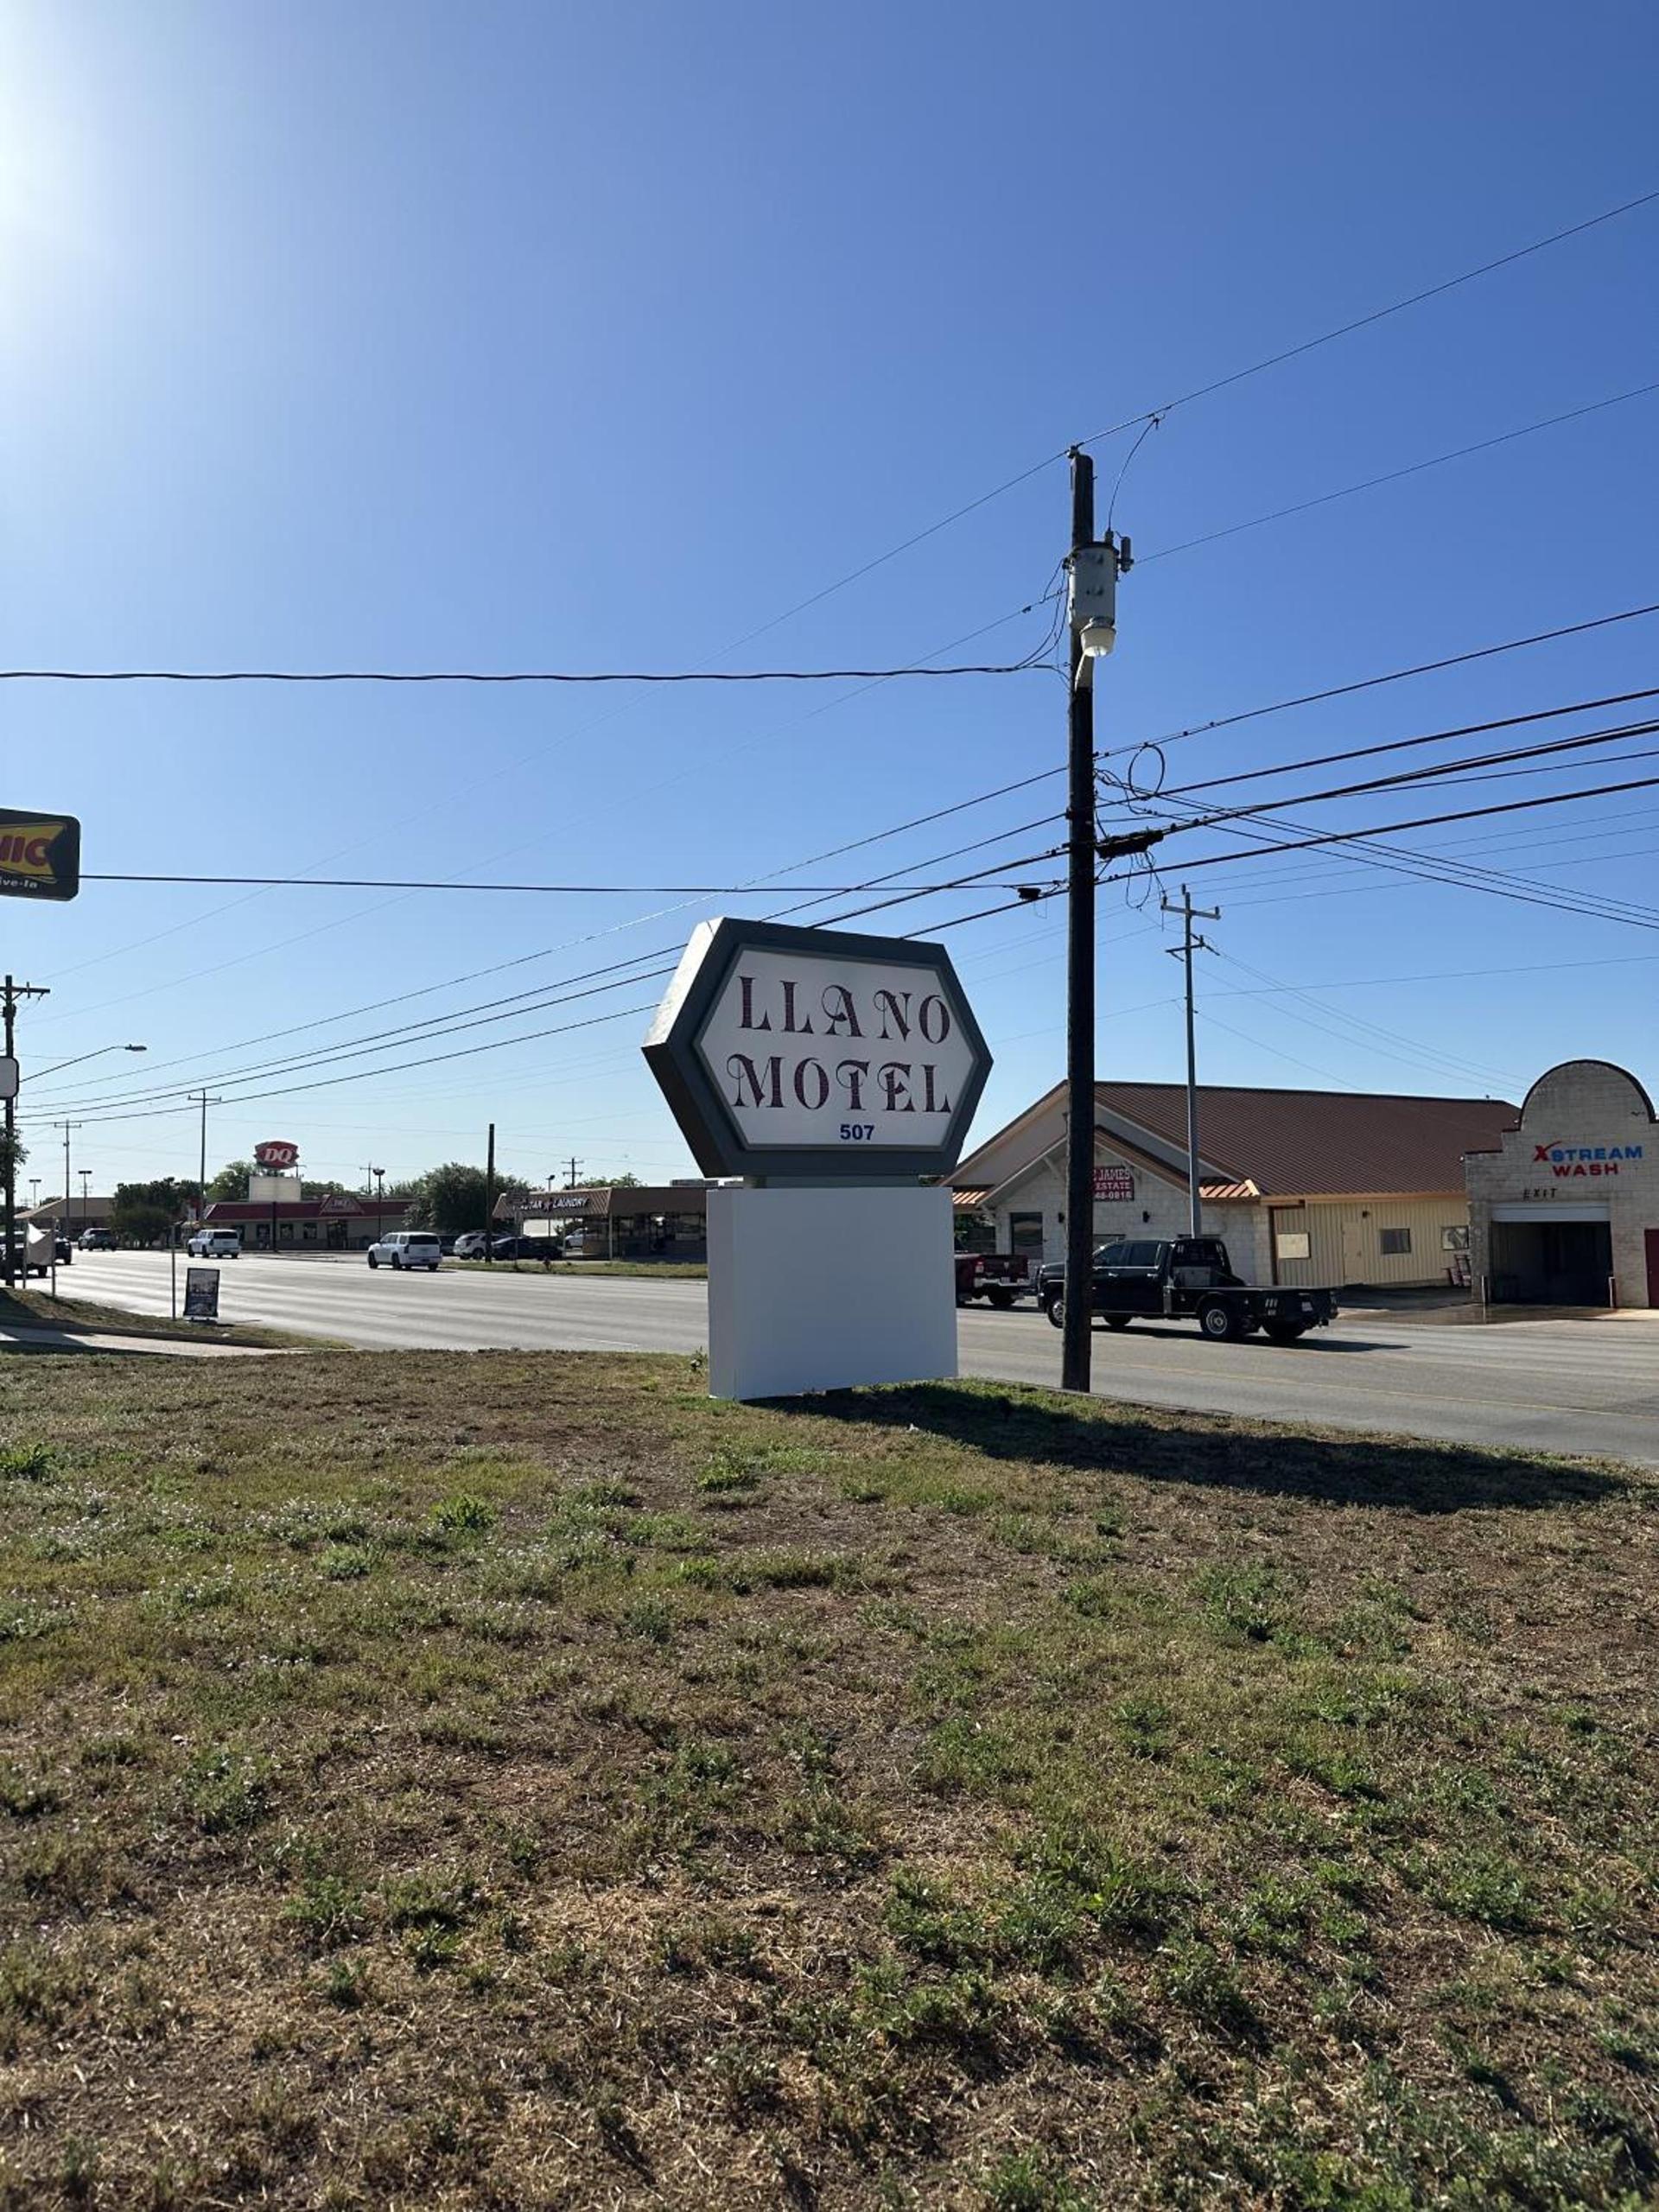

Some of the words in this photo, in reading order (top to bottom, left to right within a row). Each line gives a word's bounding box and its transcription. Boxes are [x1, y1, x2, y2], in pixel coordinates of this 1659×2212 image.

[737, 976, 950, 1044] LLANO
[726, 1052, 951, 1113] MOTEL
[839, 1123, 875, 1141] 507
[264, 1147, 294, 1164] DQ
[1533, 1141, 1643, 1163] XSTREAM
[1097, 1167, 1131, 1181] JAMES
[1552, 1163, 1619, 1178] WASH
[1094, 1182, 1131, 1191] ESTATE
[1522, 1187, 1558, 1201] EXIT
[552, 1197, 588, 1209] LAUNDRY
